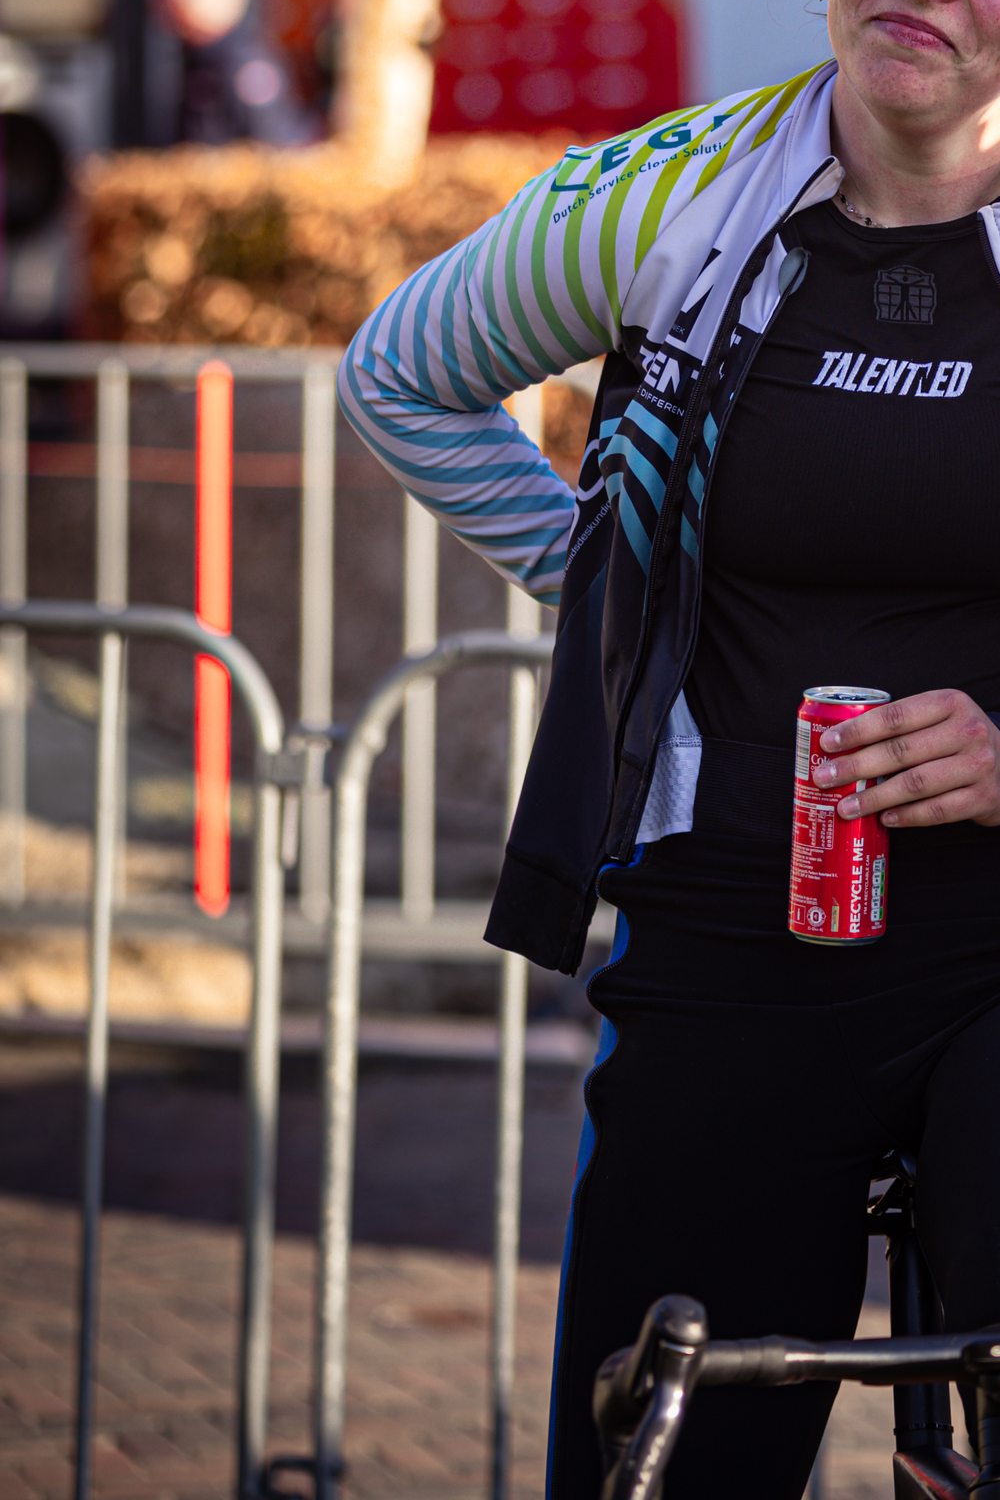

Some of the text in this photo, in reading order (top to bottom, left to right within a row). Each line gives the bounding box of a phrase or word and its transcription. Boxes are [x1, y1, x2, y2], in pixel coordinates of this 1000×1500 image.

[552, 197, 585, 224] Dutch
[588, 170, 634, 200] Service
[638, 153, 678, 173] Cloud
[849, 837, 864, 933] RECYCLE ME
